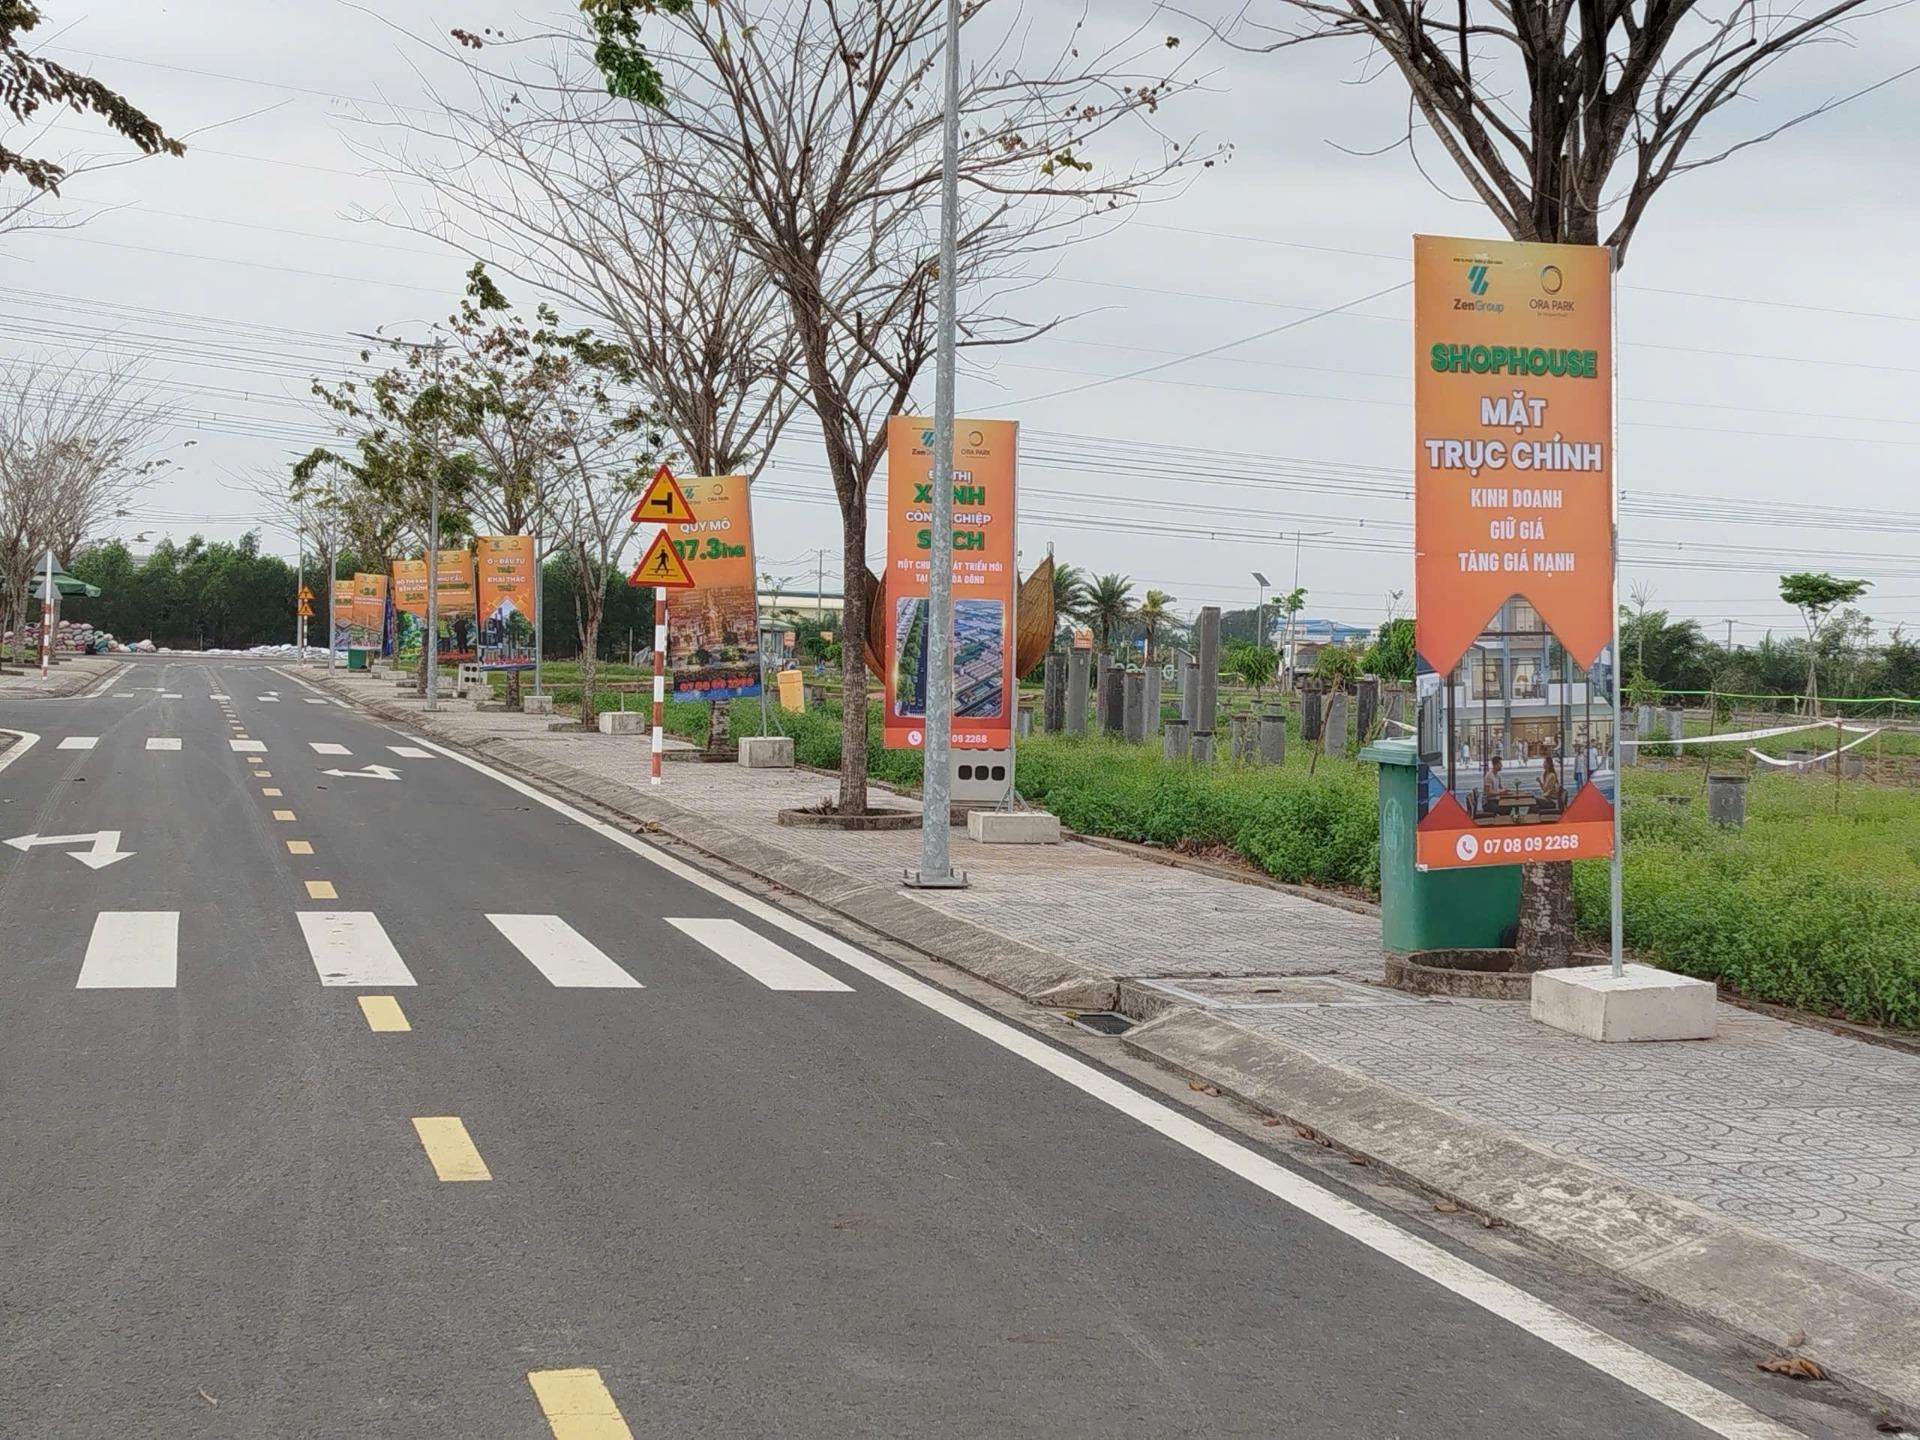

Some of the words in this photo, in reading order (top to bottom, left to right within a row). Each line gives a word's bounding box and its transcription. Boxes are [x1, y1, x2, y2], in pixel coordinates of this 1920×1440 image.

[1453, 299, 1504, 314] ZenGroup
[1529, 299, 1550, 310] ORA
[1552, 300, 1575, 311] PARK
[1431, 342, 1598, 378] SHOPHOUSE
[1480, 390, 1548, 435] MẶT
[1425, 439, 1506, 477] TRỤC
[913, 483, 985, 505] XNH
[1471, 488, 1508, 508] KINH
[1512, 489, 1563, 509] DOANH
[680, 520, 707, 534] QUY
[709, 516, 731, 531] MÔ
[905, 508, 933, 522] CÔN
[954, 511, 992, 528] GHIỆP
[1490, 516, 1515, 540] GIỮ
[1519, 517, 1545, 540] GIÁ
[916, 529, 985, 551] SCH
[1458, 549, 1499, 571] TĂNG
[1503, 548, 1529, 571] GIÁ
[1533, 552, 1575, 578] MẠNH
[1483, 839, 1501, 854] 07
[1503, 838, 1521, 853] 08
[1525, 836, 1542, 852] 09
[1545, 834, 1578, 850] 2268
